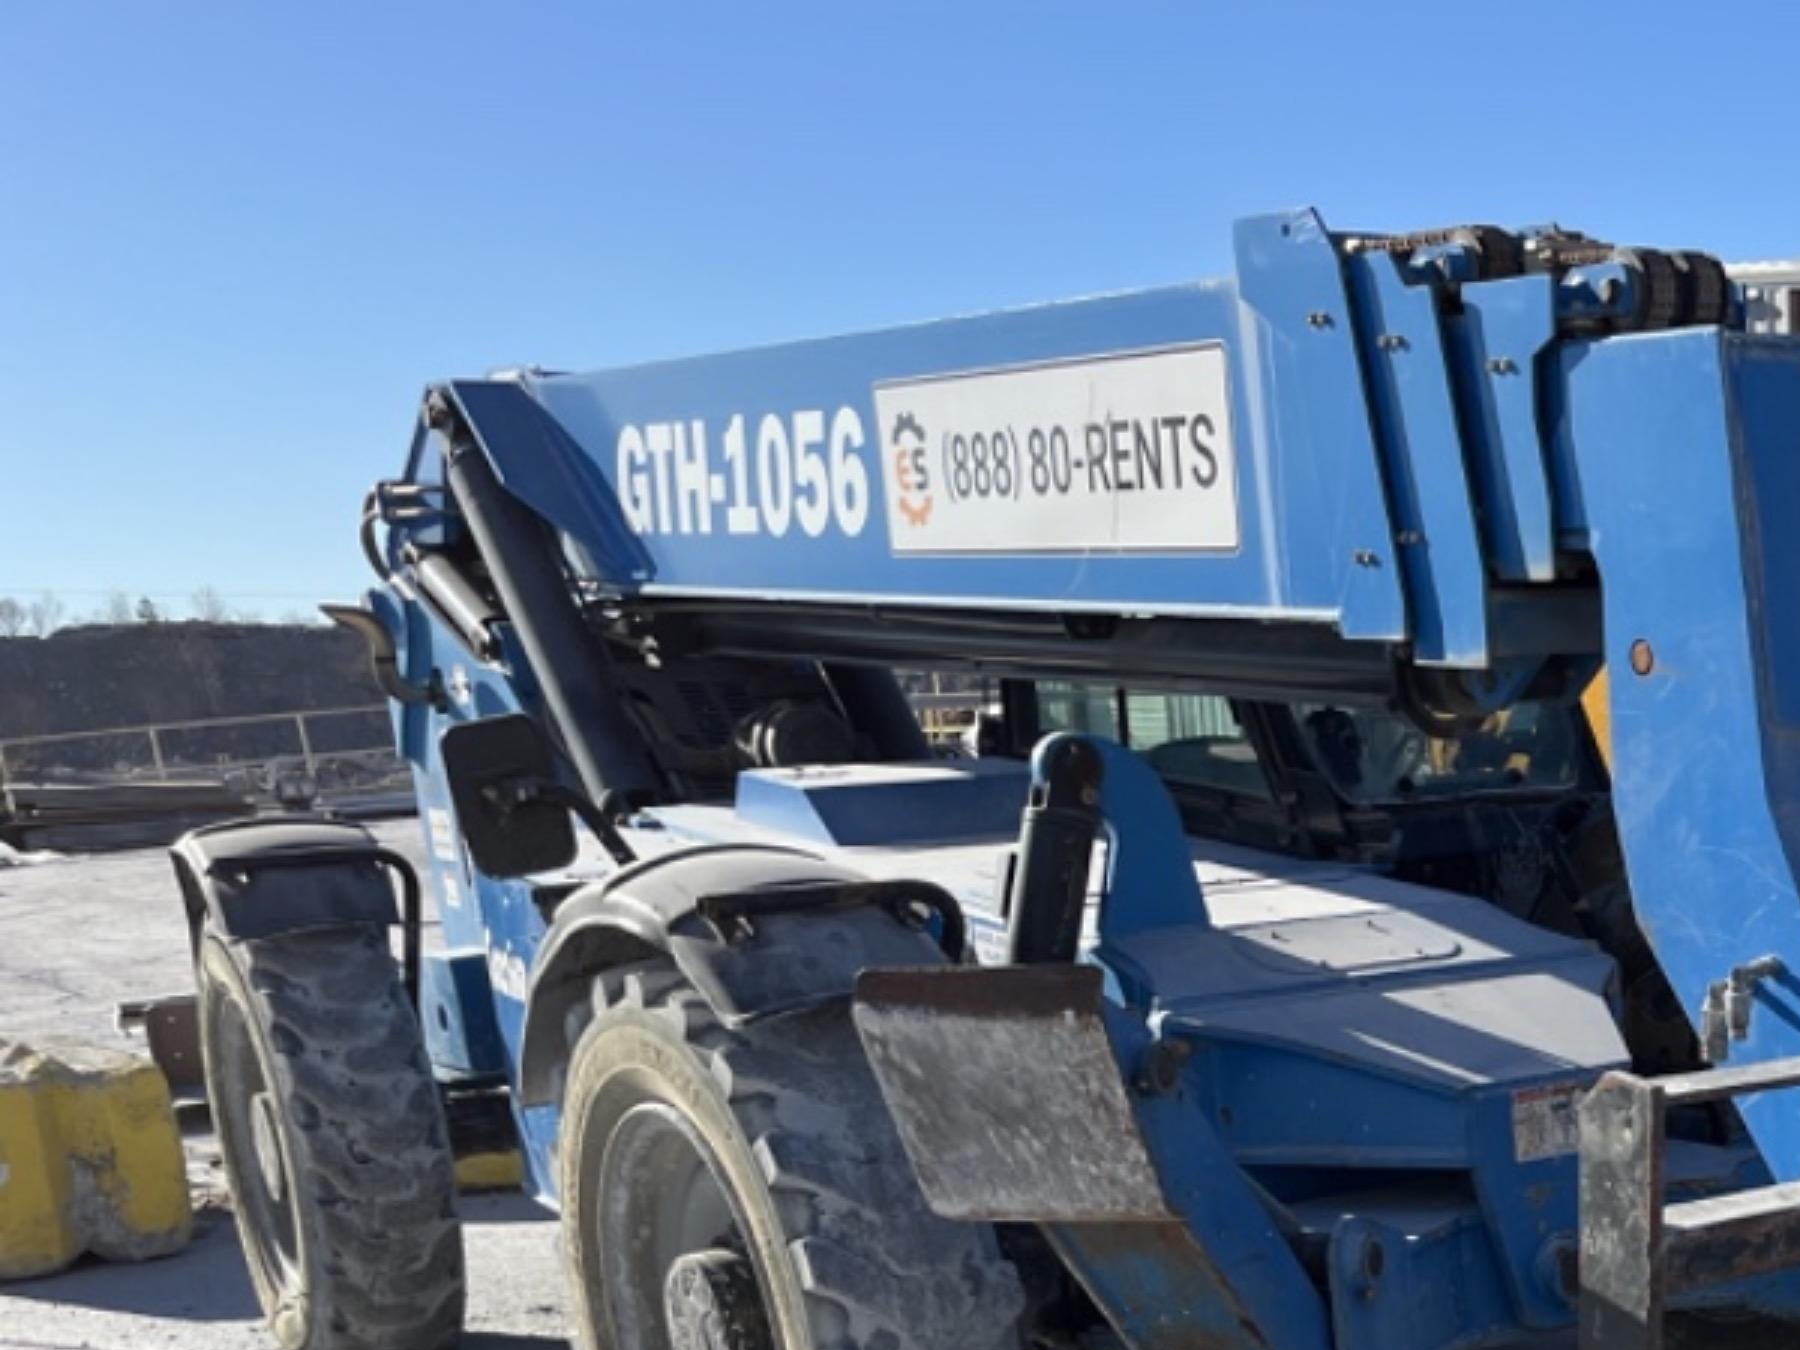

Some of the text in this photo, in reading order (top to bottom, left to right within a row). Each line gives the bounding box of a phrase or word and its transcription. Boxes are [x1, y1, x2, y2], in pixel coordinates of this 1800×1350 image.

[616, 405, 869, 540] GTH-1056
[895, 447, 930, 491] ES
[942, 412, 1220, 503] (888) 80-RENTS
